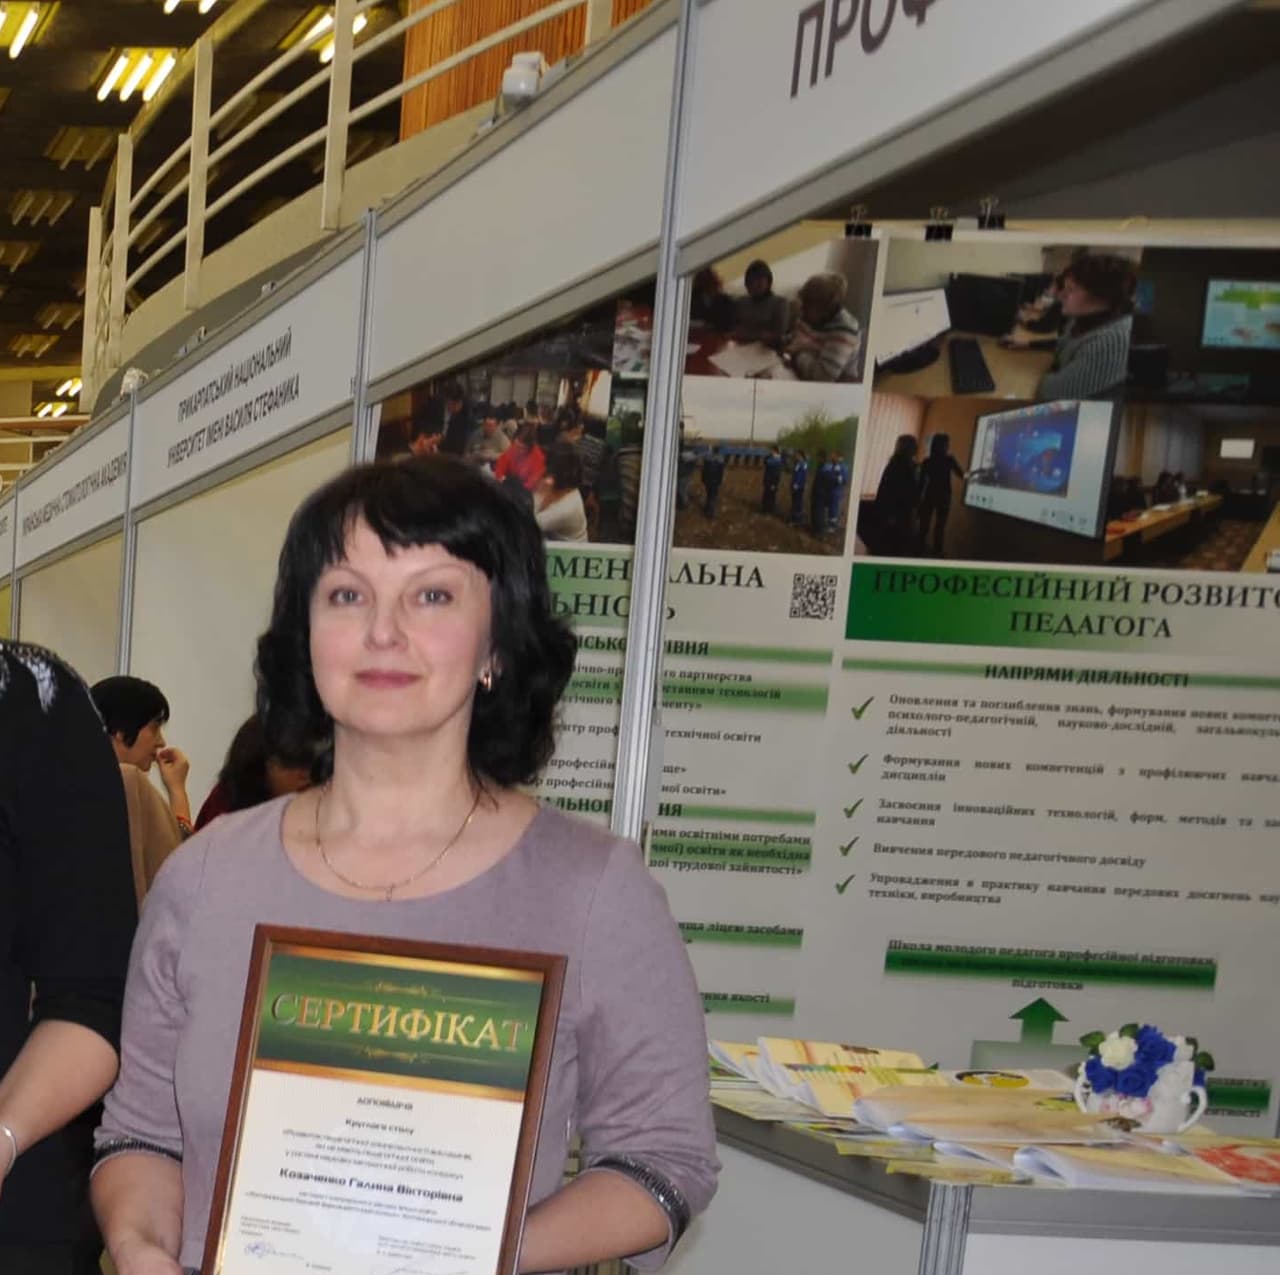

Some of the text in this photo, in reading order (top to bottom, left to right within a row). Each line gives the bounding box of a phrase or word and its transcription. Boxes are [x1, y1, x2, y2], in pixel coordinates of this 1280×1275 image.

[873, 568, 1134, 604] ПРОФЕСІЙНИЙ
[1008, 611, 1172, 639] ПЕДАГОГА
[984, 664, 1189, 688] НАПРЯМИ ДІЯЛЬНОСТІ
[271, 992, 530, 1053] СЕРТИФІКАТ
